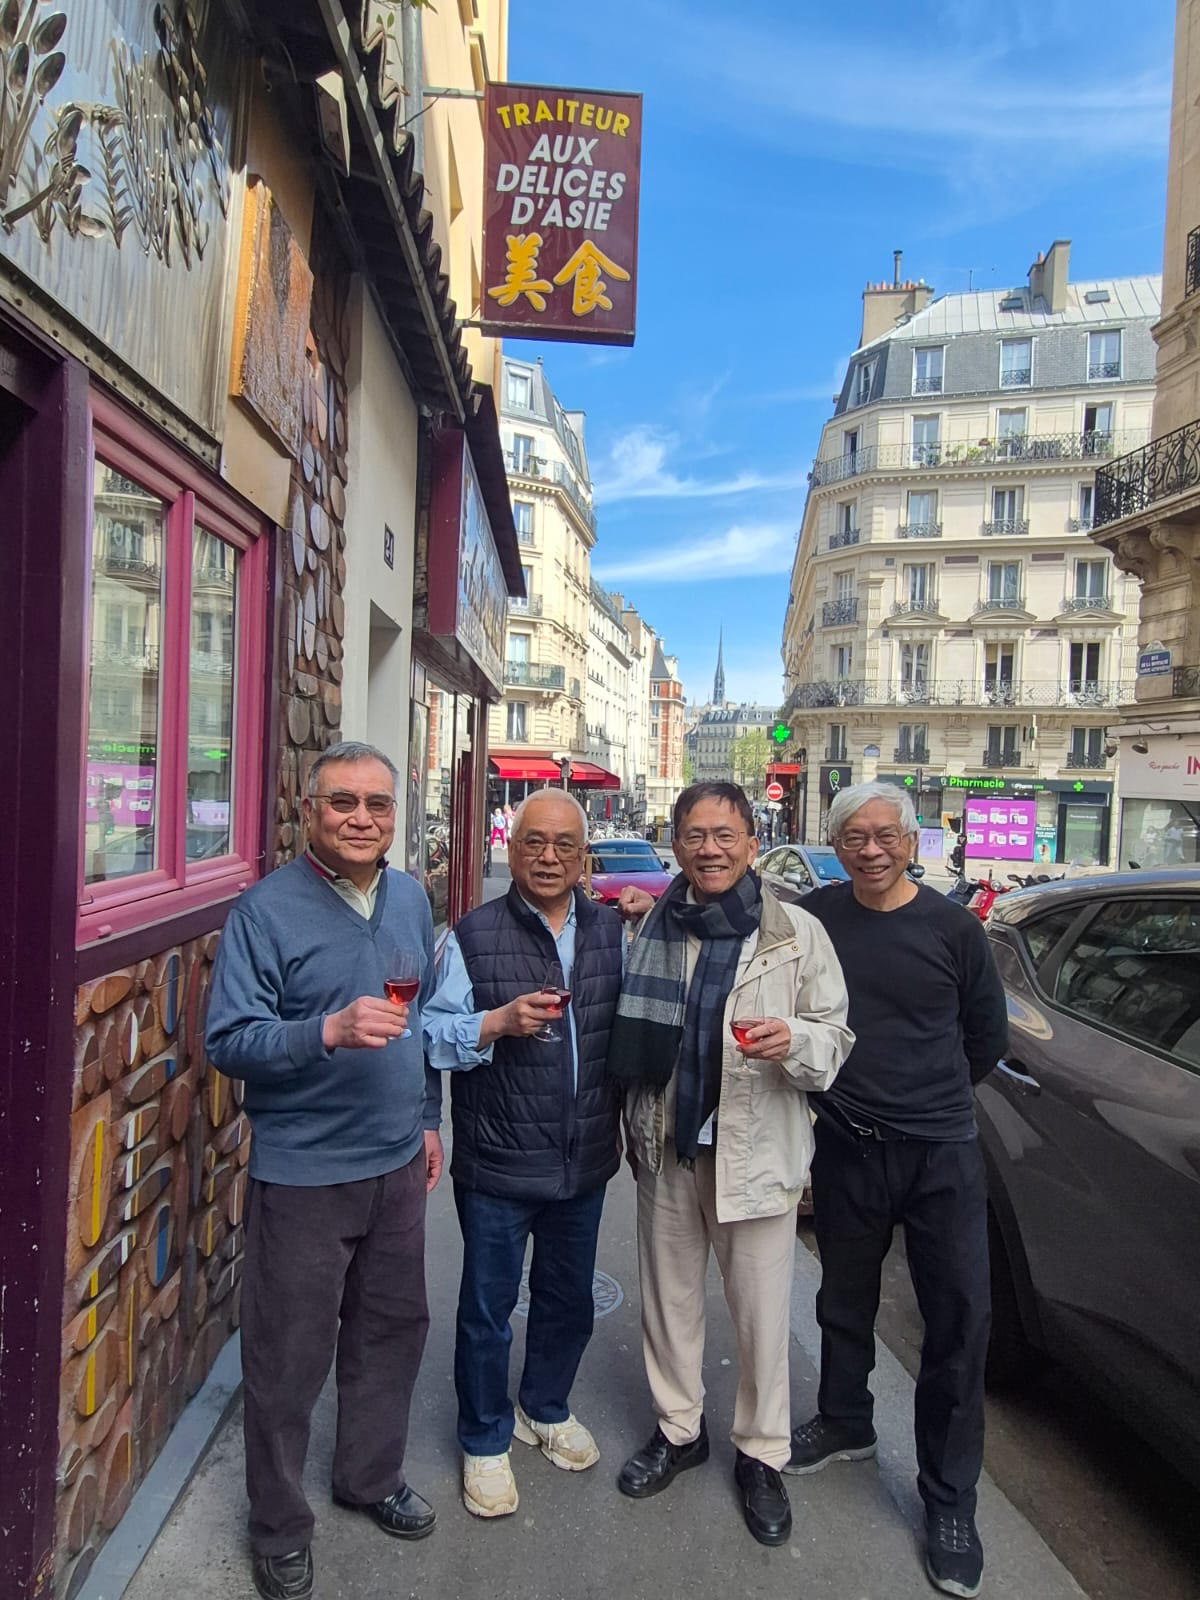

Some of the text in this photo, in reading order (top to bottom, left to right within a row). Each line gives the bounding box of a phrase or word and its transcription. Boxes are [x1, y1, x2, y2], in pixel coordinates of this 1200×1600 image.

[496, 98, 631, 137] TRAITEUR
[528, 133, 600, 166] AUX
[496, 163, 627, 200] DELICES
[511, 196, 613, 230] D'ASIE
[487, 232, 631, 317] 美食
[950, 777, 1005, 788] Pharmacie
